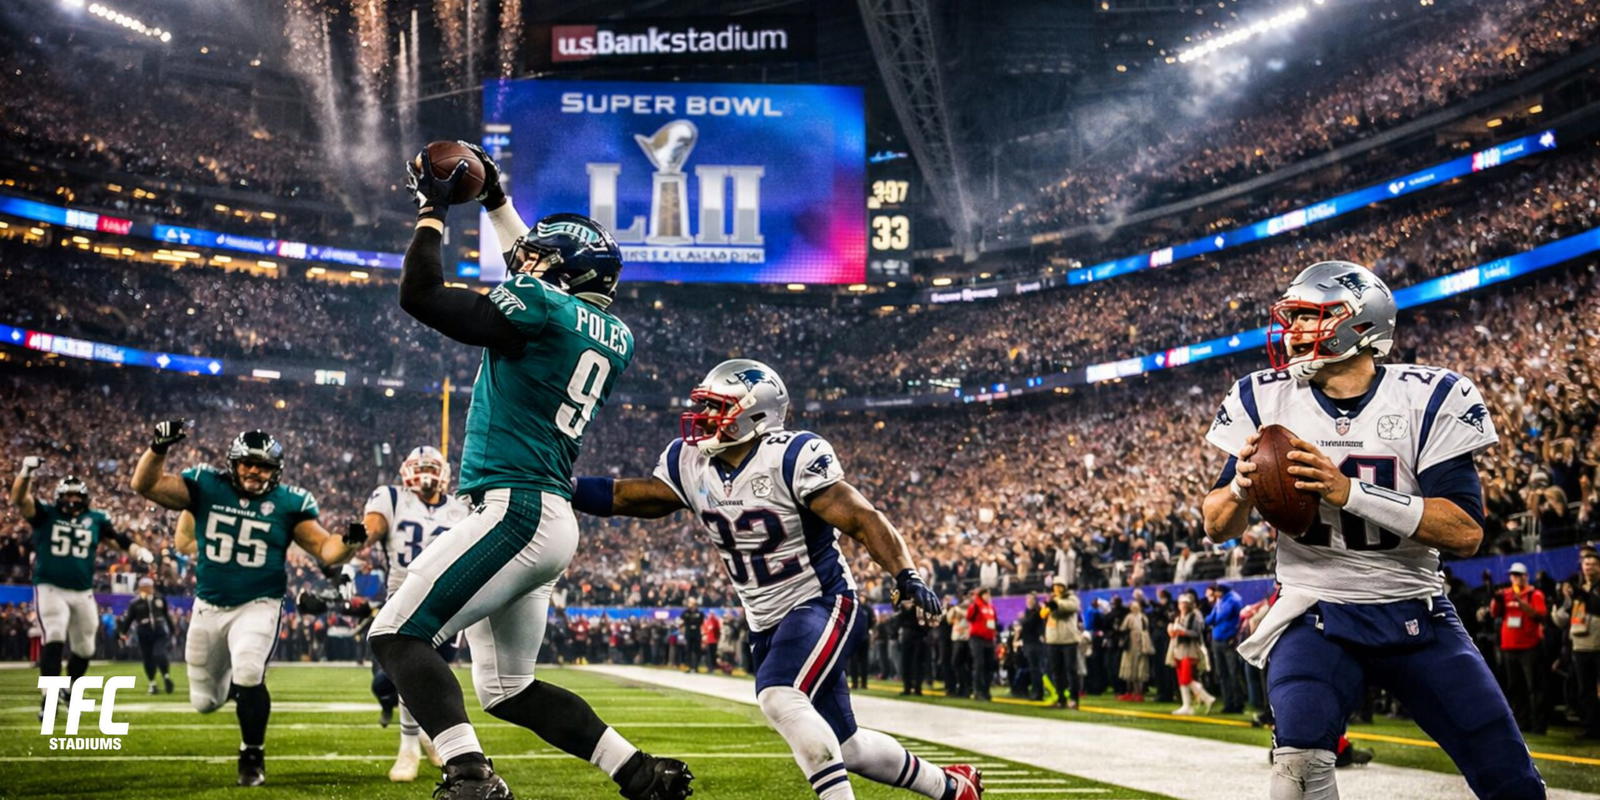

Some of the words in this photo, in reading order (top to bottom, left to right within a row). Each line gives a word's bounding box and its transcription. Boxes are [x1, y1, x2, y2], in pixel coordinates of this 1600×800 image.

[561, 92, 675, 114] SUPER
[686, 96, 783, 117] BOWL
[872, 214, 909, 250] 33
[575, 305, 629, 355] POLES
[555, 348, 611, 439] 9
[51, 524, 92, 559] 53
[205, 511, 272, 568] 55
